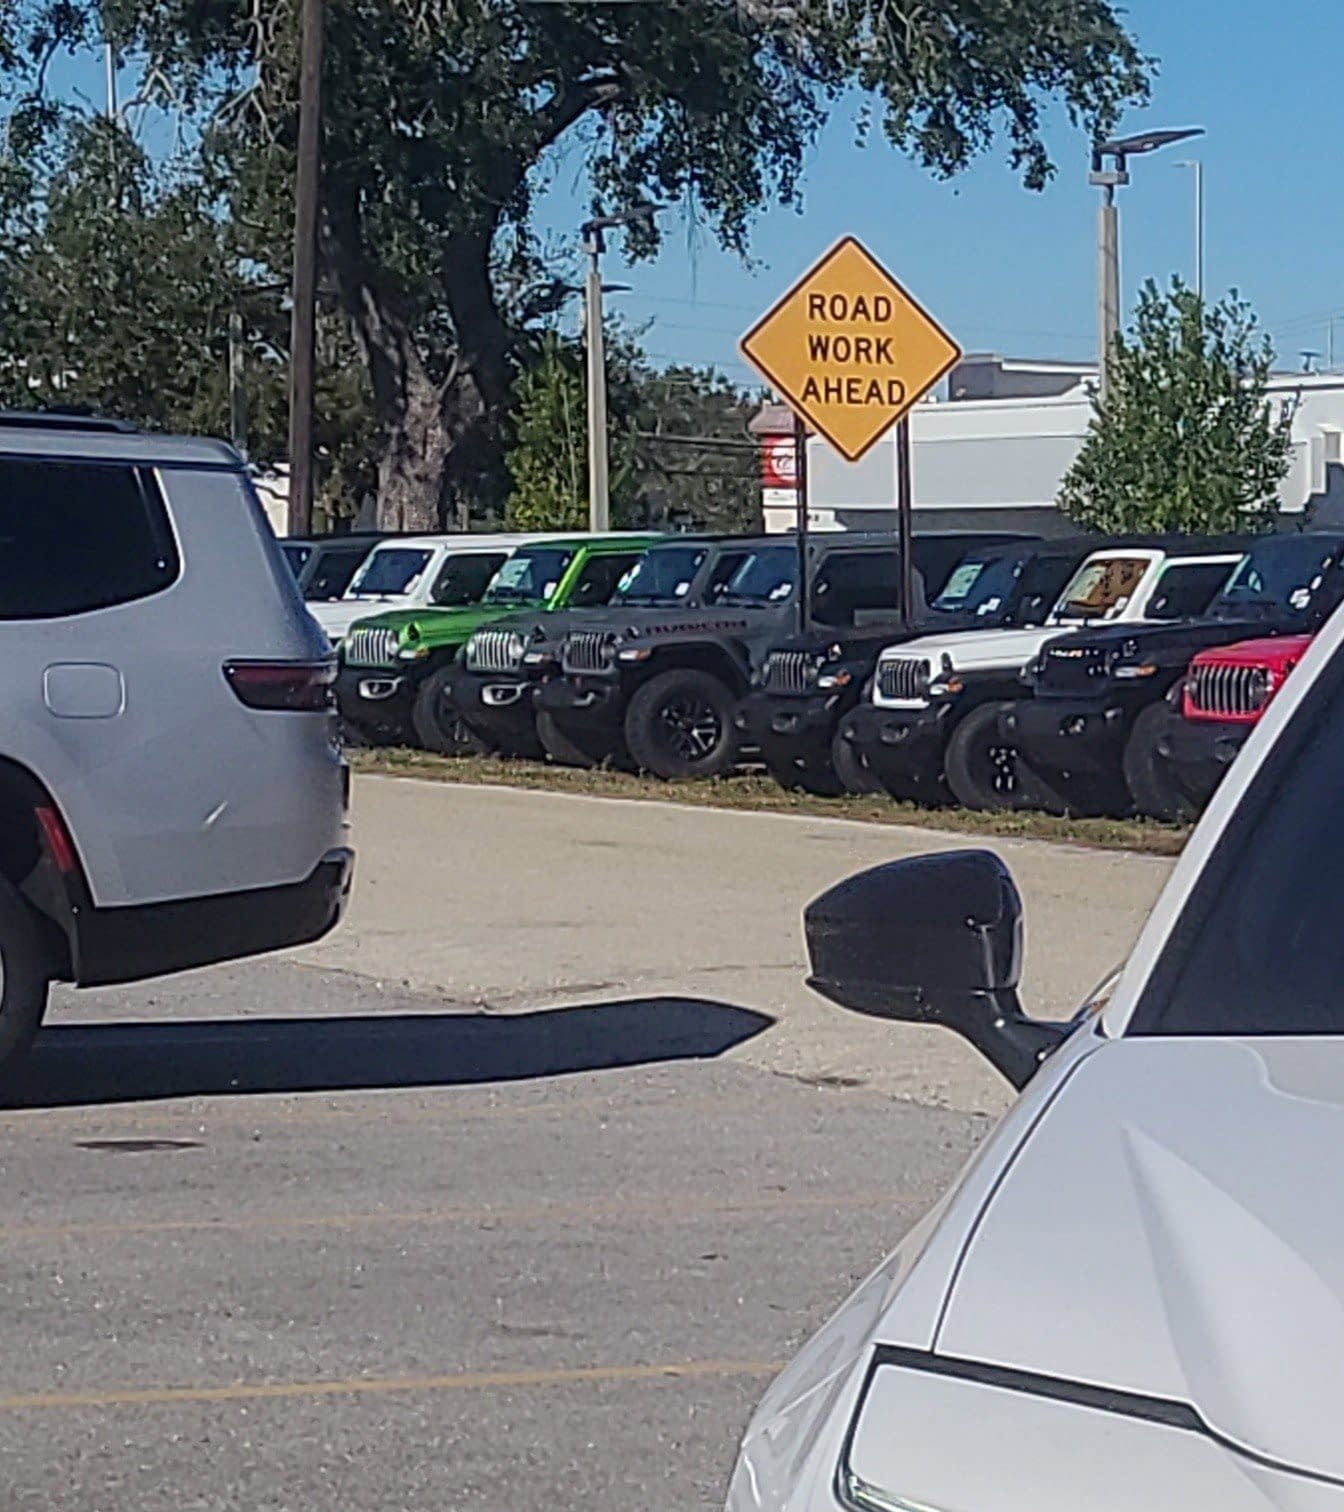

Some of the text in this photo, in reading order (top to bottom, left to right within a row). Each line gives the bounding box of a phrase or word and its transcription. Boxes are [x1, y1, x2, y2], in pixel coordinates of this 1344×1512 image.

[808, 293, 892, 322] ROAD
[808, 334, 894, 364] WORK
[801, 376, 906, 405] AHEAD
